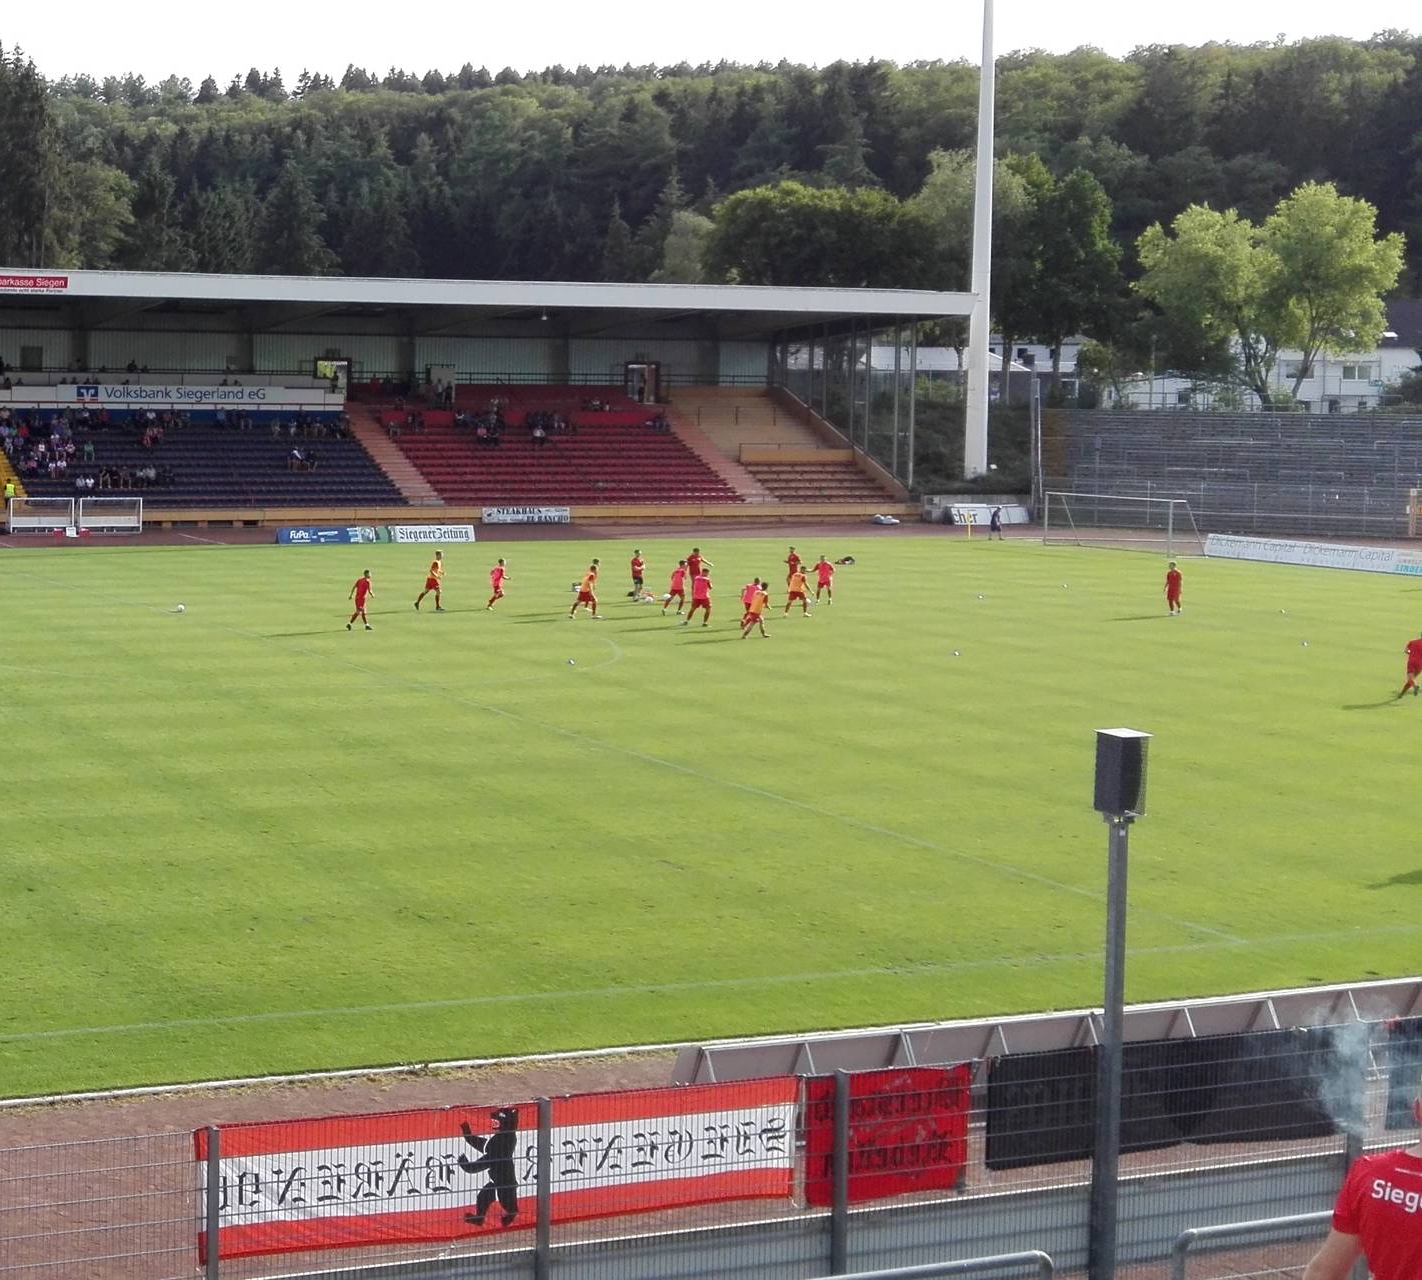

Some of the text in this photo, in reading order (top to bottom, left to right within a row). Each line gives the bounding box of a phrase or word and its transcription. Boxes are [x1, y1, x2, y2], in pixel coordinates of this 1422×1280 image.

[36, 277, 65, 288] Siegen
[105, 386, 266, 402] Volksbank Siegerland eG
[497, 507, 542, 515] STEAKHAUS
[538, 515, 569, 523] RANCHO
[1371, 1178, 1422, 1213] Sieg
